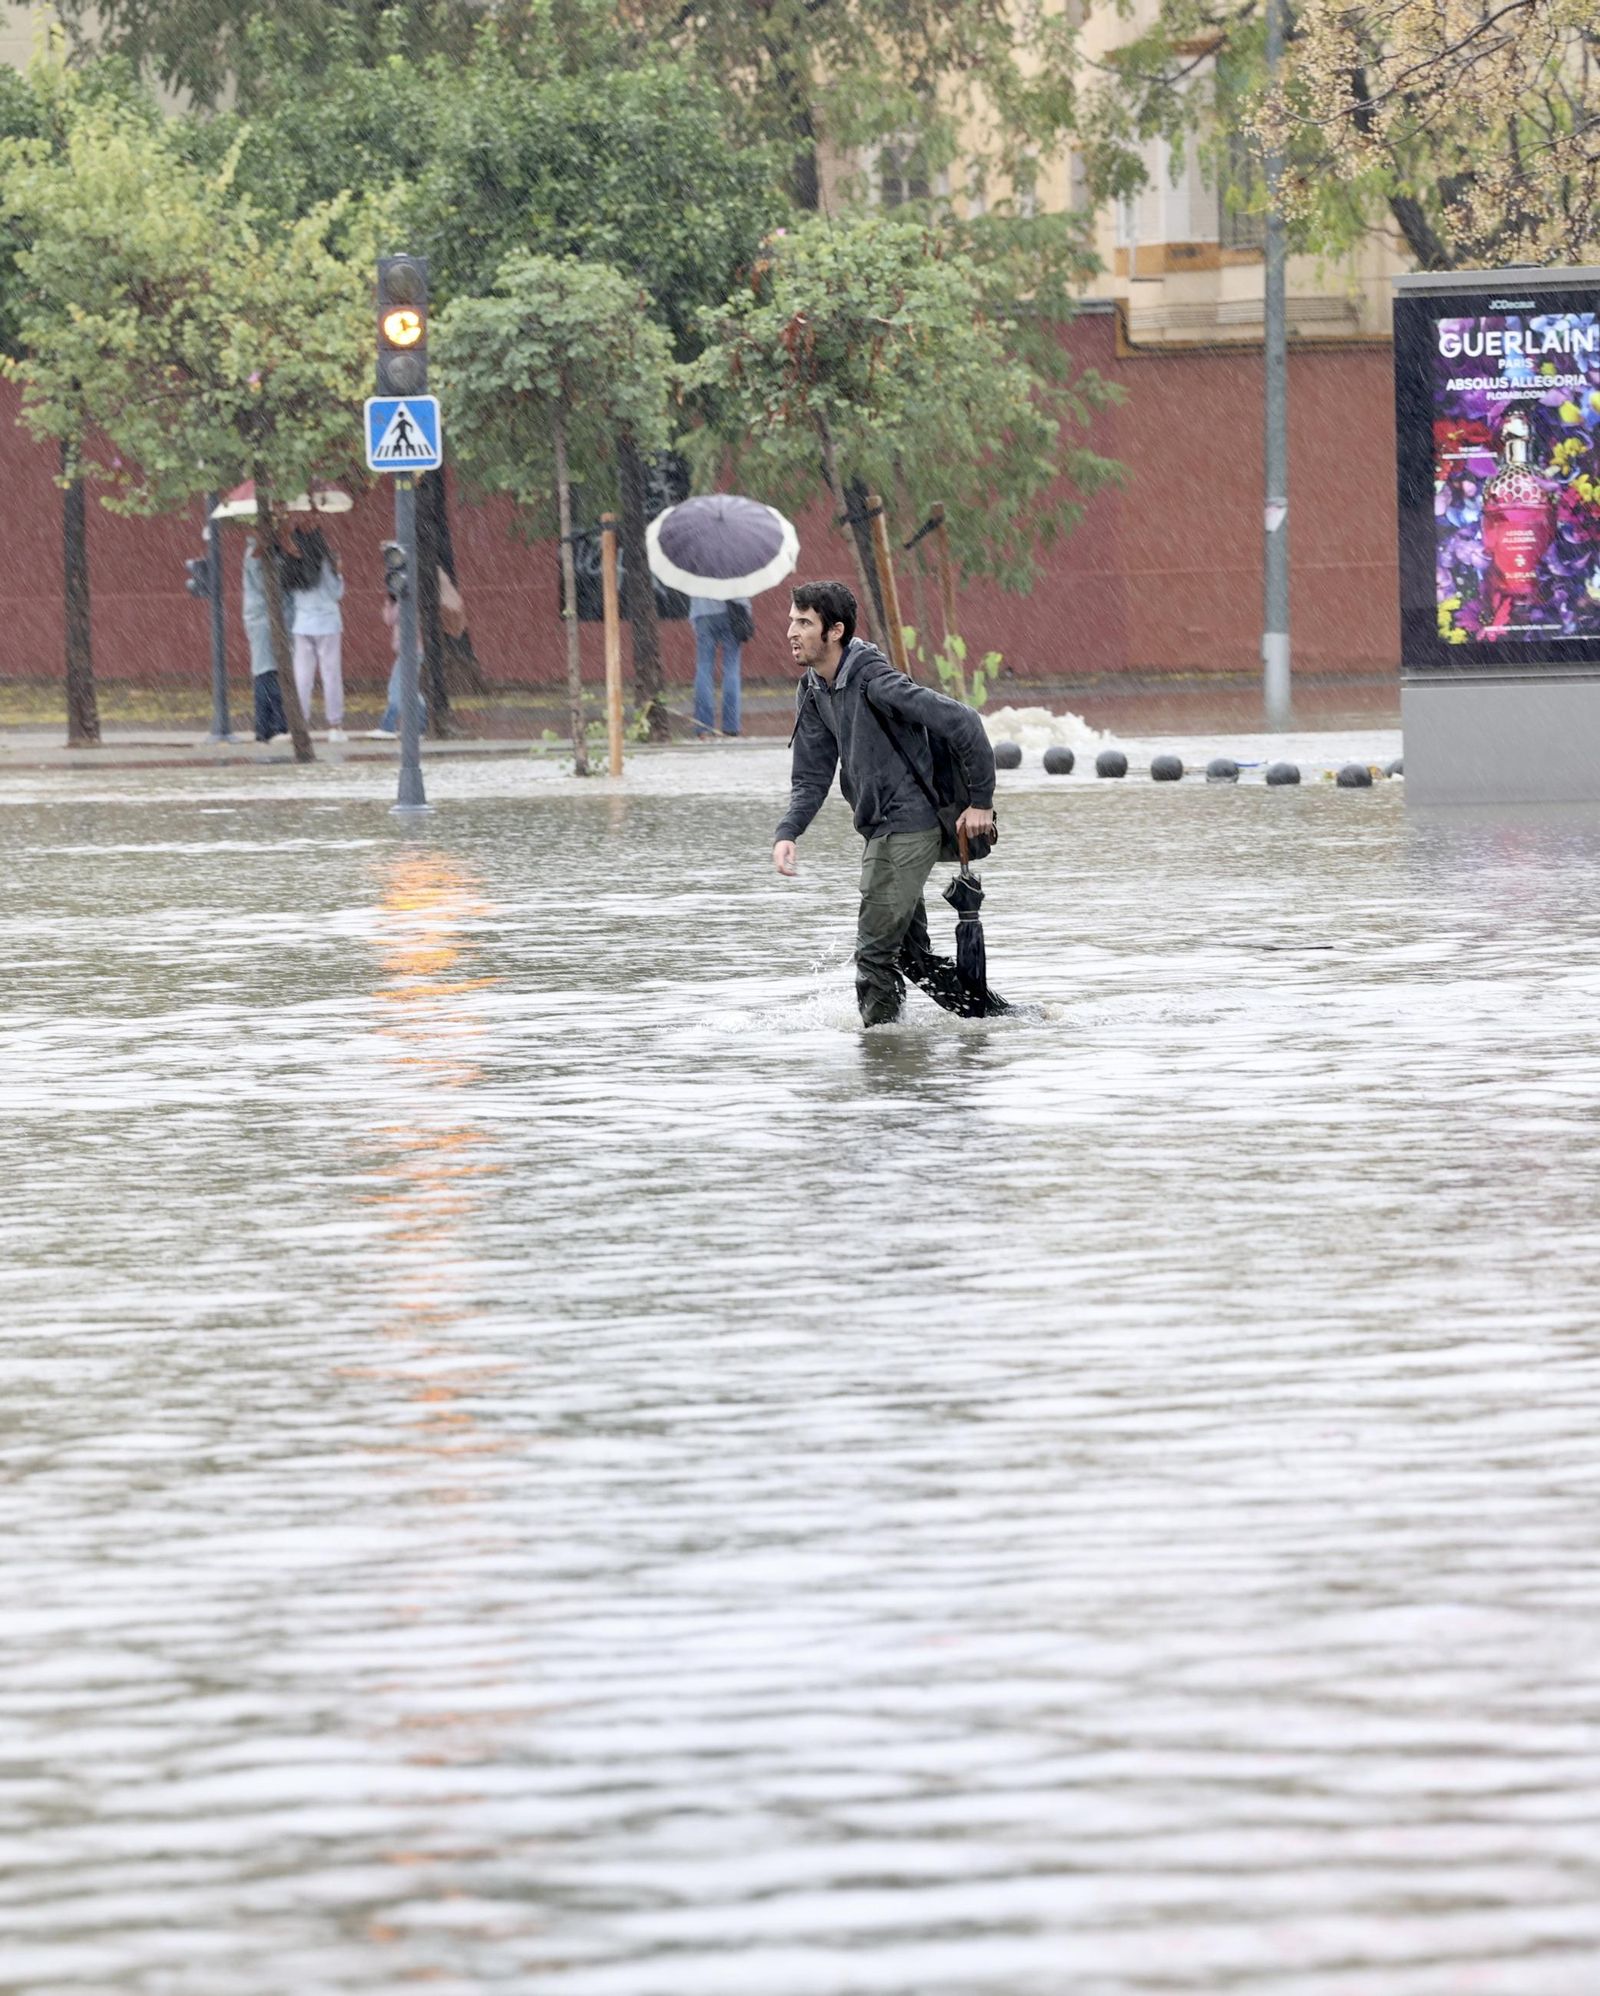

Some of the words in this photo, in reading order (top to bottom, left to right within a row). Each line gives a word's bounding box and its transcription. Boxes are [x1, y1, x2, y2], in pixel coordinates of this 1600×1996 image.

[1439, 328, 1594, 358] GUERLAIN
[1498, 358, 1534, 369] PARIS
[1446, 378, 1508, 391] ABSOLUS
[1511, 374, 1588, 388] ALLEGORIA
